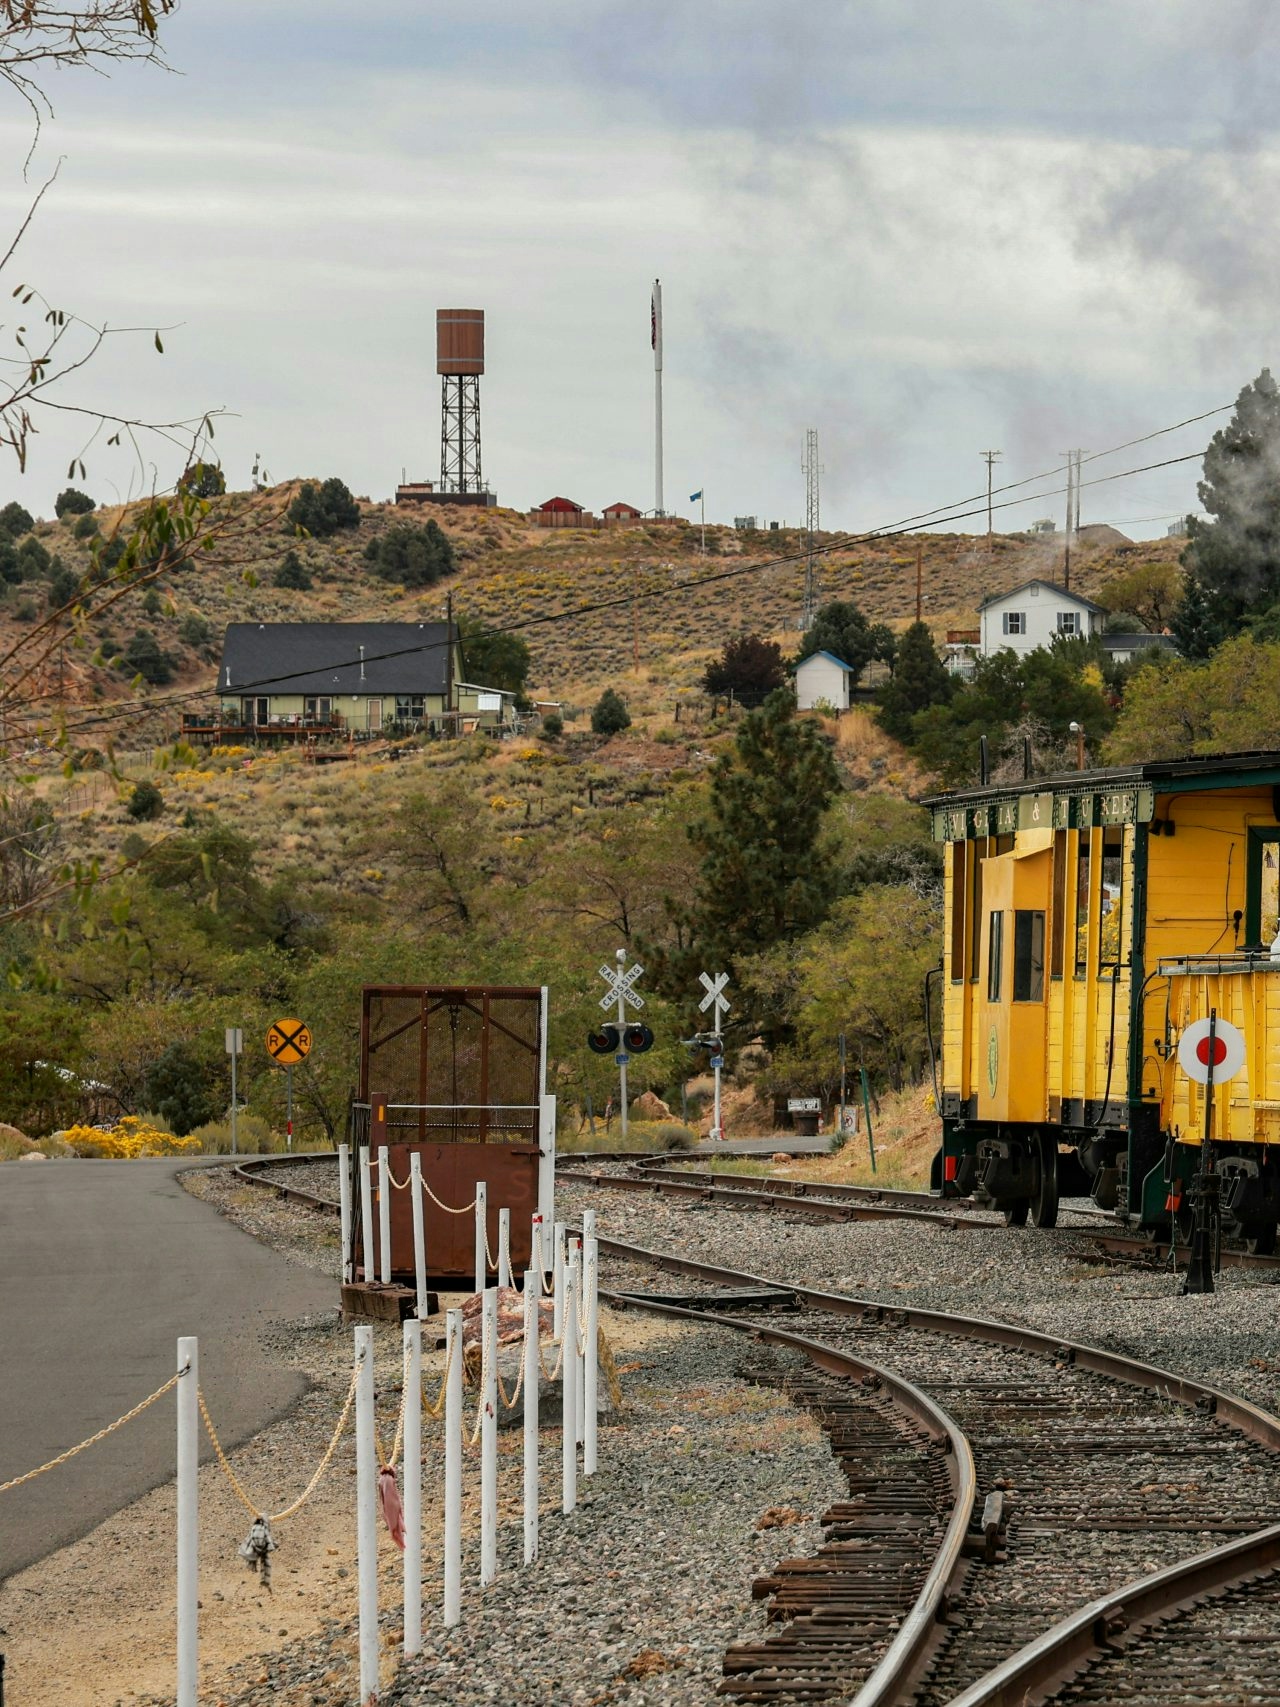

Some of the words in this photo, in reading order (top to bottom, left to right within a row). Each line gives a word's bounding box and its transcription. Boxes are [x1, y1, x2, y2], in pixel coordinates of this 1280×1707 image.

[952, 807, 1012, 831] VIGIIA
[1032, 801, 1040, 821] &
[1061, 794, 1130, 819] TUKEE
[601, 966, 617, 985] RAIL
[623, 988, 642, 1008] ROAD
[602, 967, 641, 1007] CROSSING
[269, 1035, 278, 1046] R
[299, 1035, 308, 1046] R
